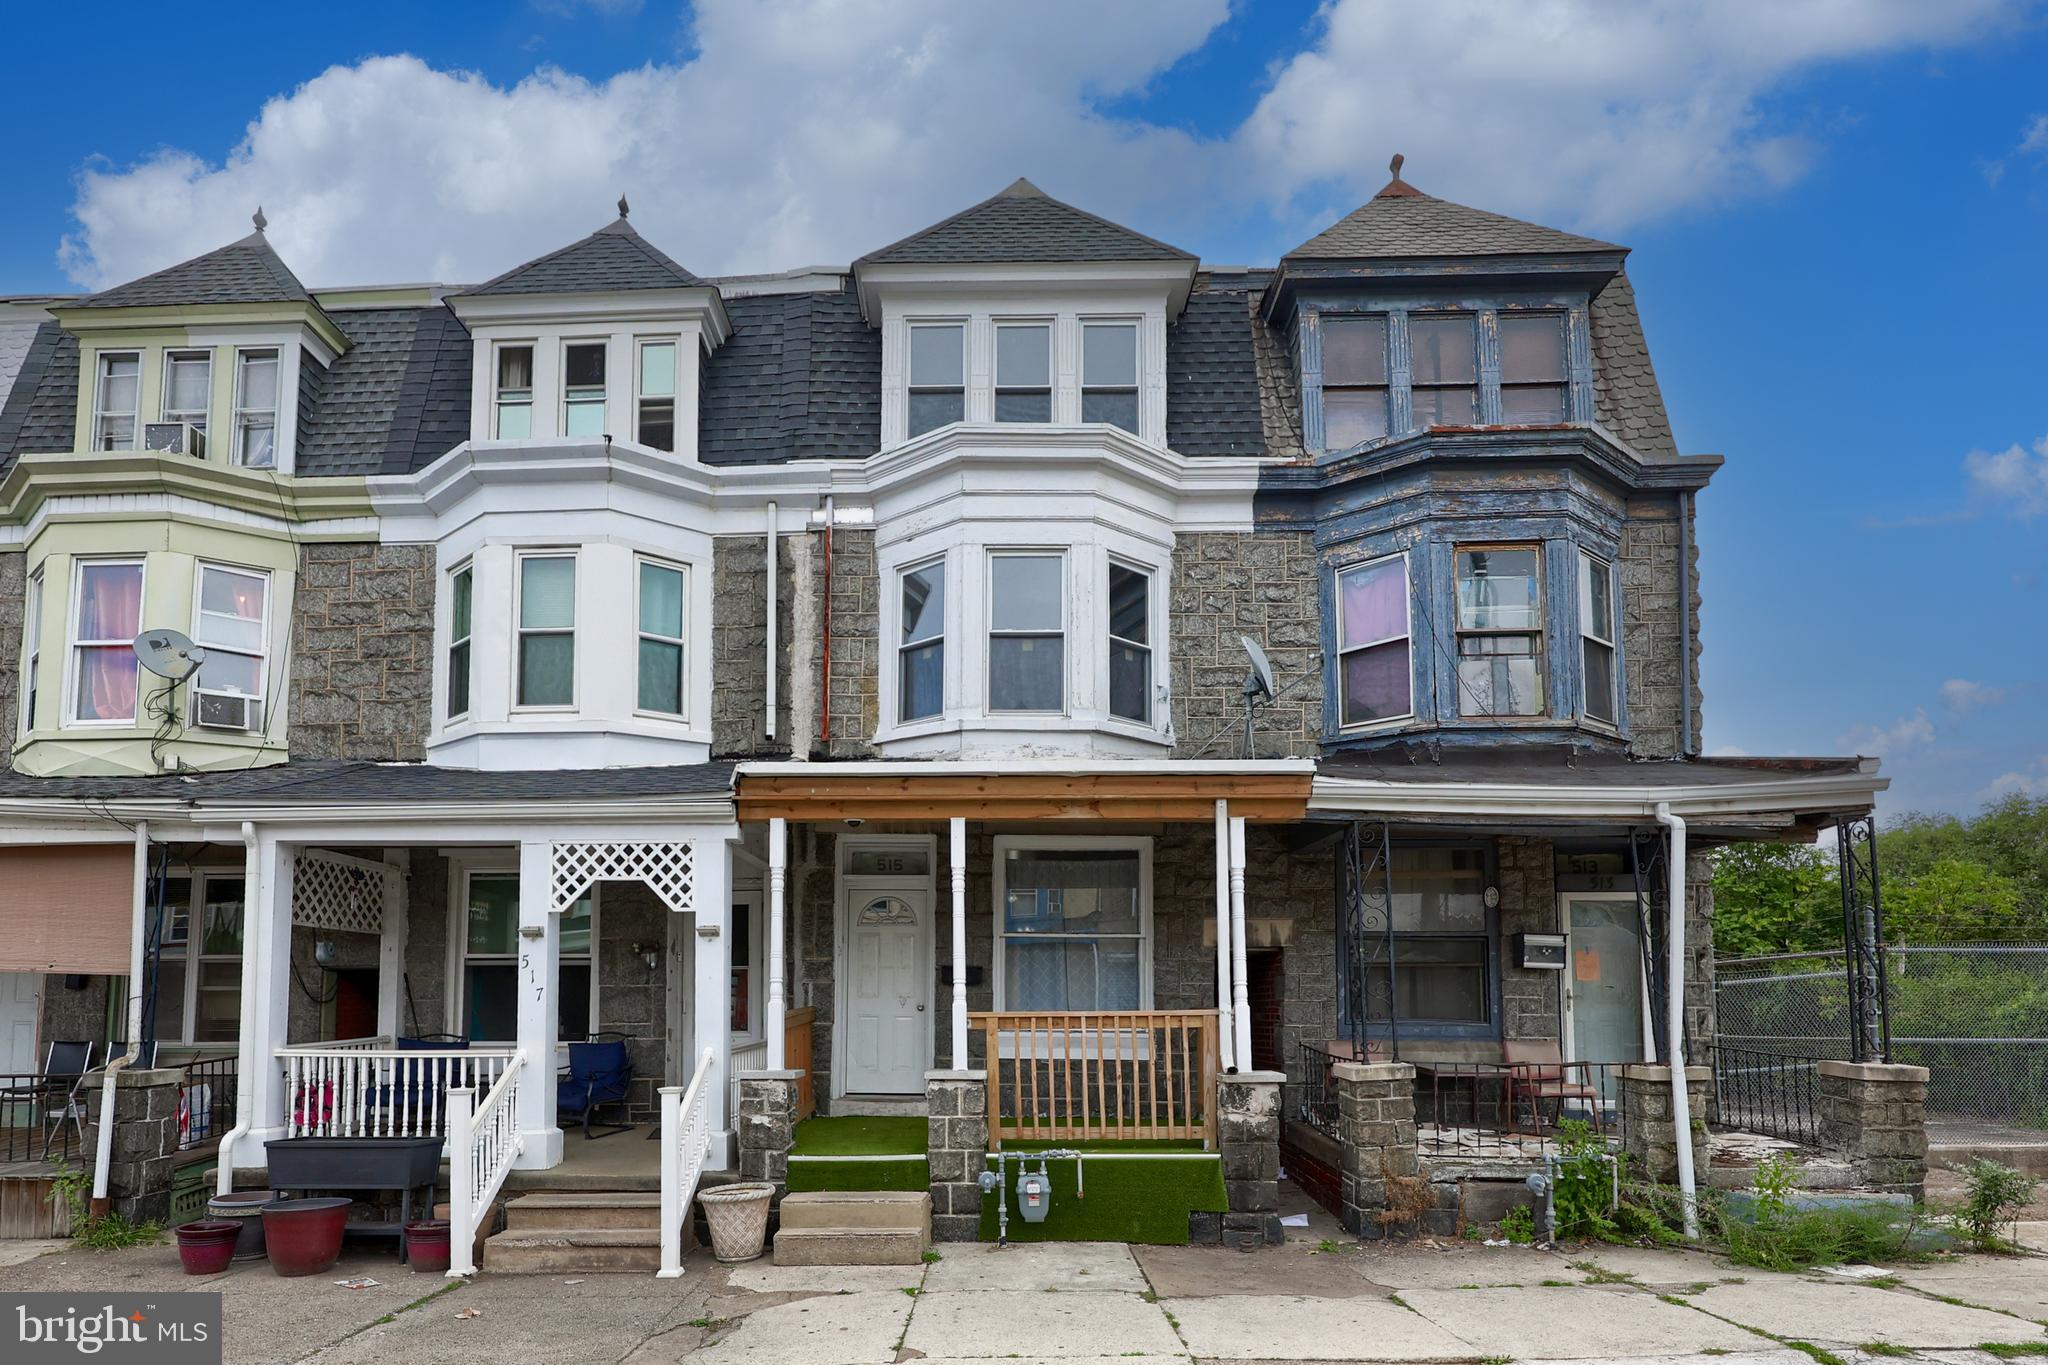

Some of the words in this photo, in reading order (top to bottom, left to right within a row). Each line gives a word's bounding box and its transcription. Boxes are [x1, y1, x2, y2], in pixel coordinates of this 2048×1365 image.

[877, 859, 903, 871] 515
[1571, 860, 1598, 873] 513
[521, 953, 544, 1002] 517
